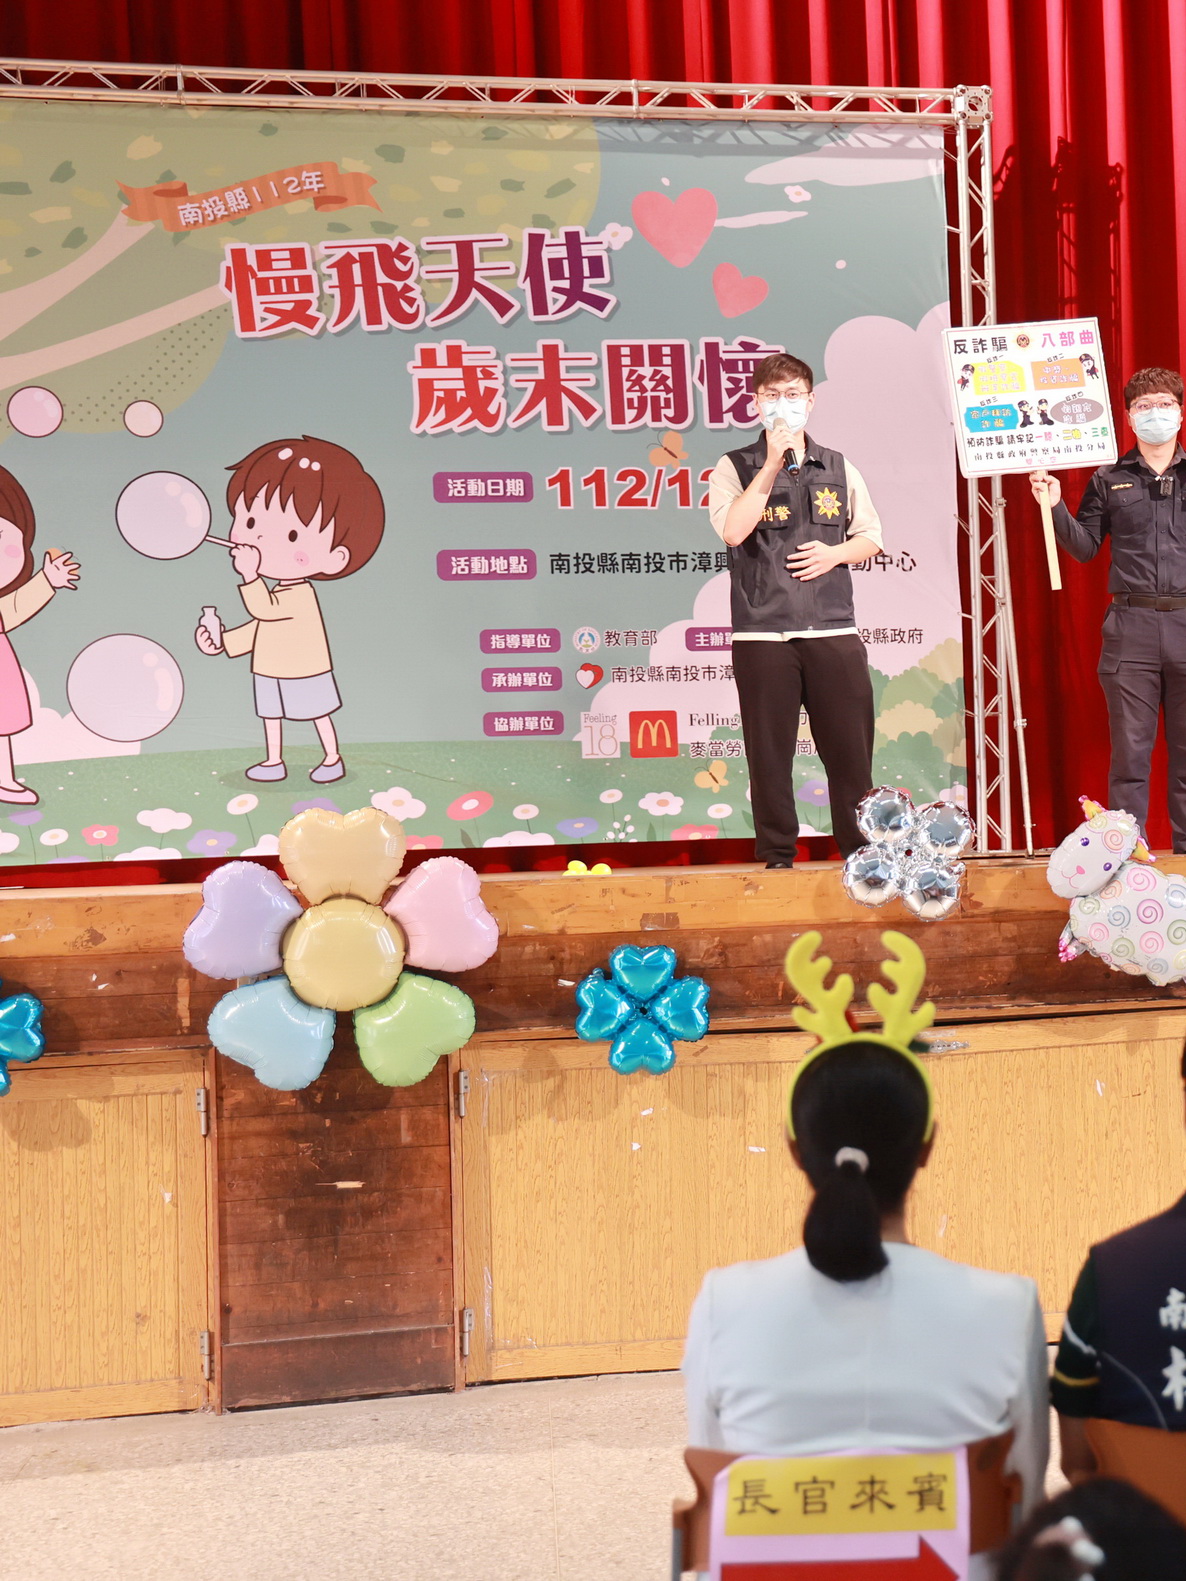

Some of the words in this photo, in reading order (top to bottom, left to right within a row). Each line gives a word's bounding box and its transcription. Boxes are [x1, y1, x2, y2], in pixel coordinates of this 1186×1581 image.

[177, 170, 325, 226] 南投縣112年
[222, 229, 618, 334] 慢飛天使
[953, 336, 1008, 355] 反詐騙
[1041, 330, 1094, 348] 八部曲
[409, 339, 782, 430] 歲末關懷
[447, 478, 524, 497] 活動日期
[451, 556, 528, 575] 活動地點
[490, 634, 551, 649] 指導單位
[604, 630, 657, 647] 教育部
[492, 672, 553, 687] 承辦單位
[493, 717, 555, 733] 協辦單位
[583, 713, 618, 726] Feeling
[733, 1472, 948, 1516] 長官來賓
